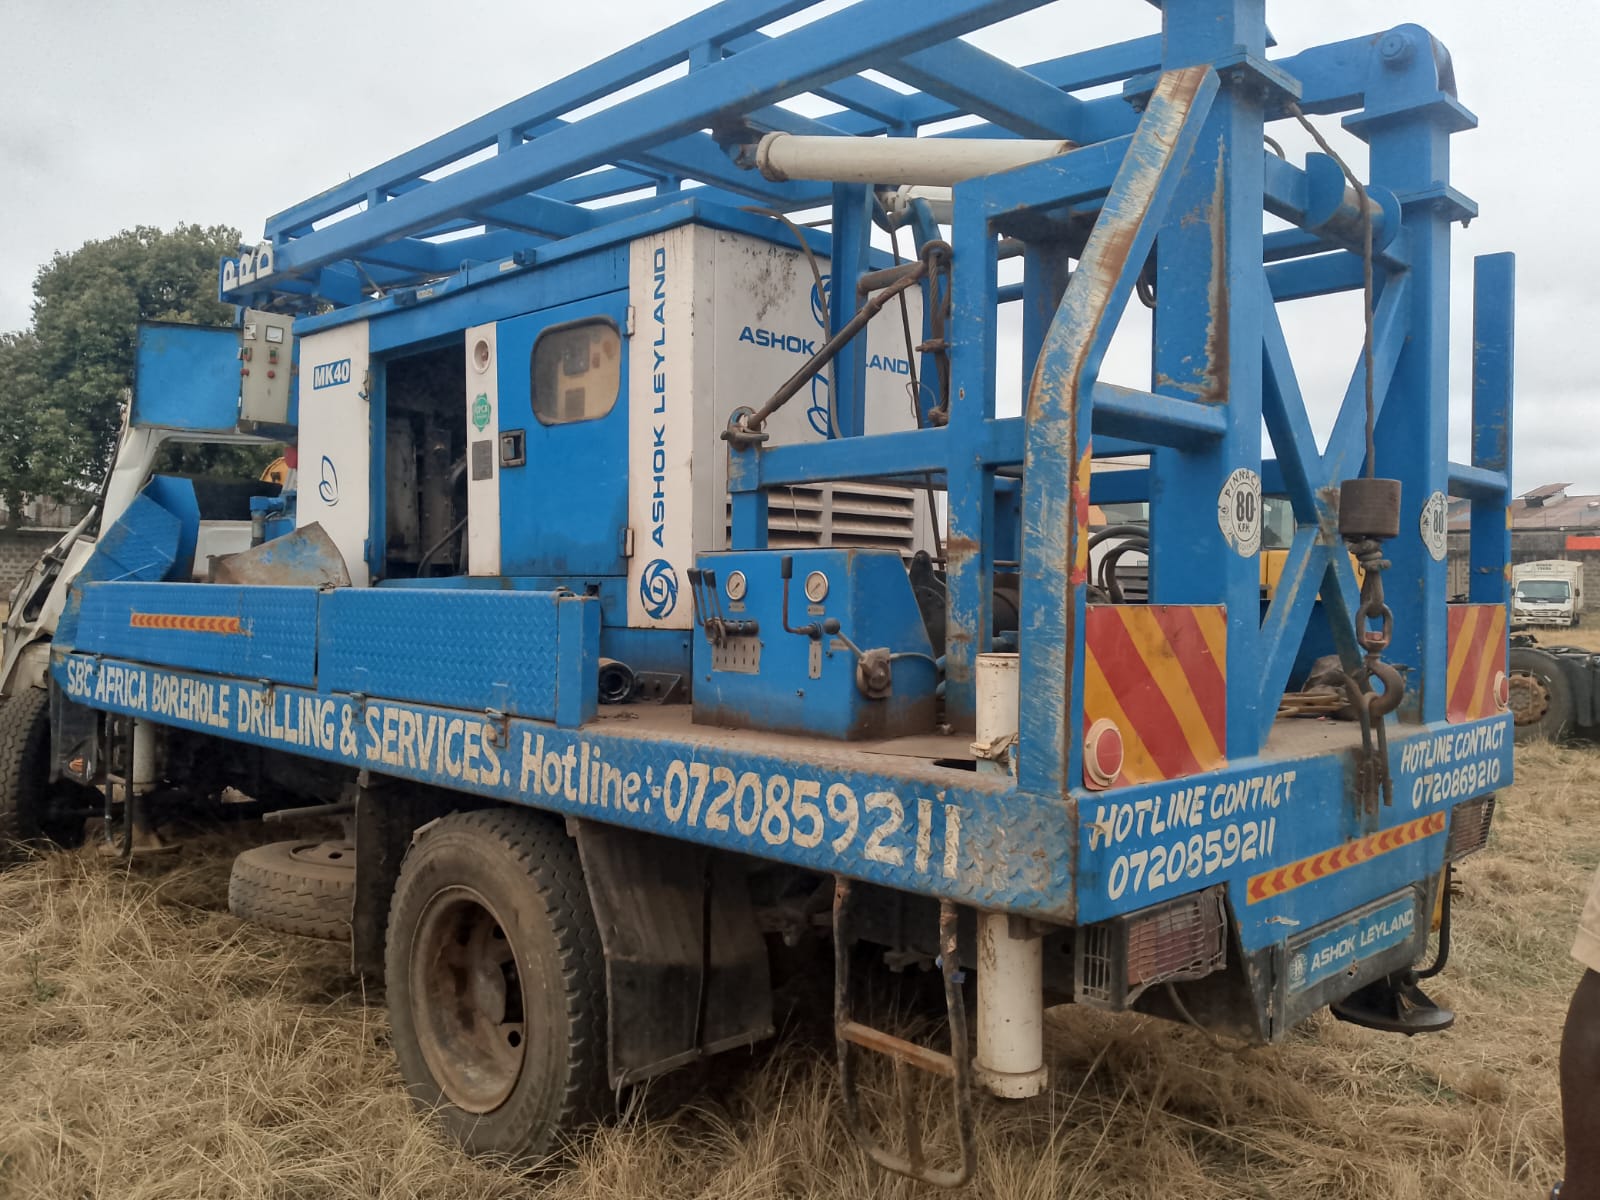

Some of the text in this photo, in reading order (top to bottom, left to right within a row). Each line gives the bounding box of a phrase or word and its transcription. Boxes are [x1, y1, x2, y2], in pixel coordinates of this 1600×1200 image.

[739, 326, 816, 356] ASHOK
[314, 360, 350, 388] MK40
[652, 247, 666, 548] ASHOK LEYLAND
[1236, 490, 1255, 523] 80
[1433, 509, 1444, 535] 80
[66, 658, 93, 698] SBC
[94, 664, 148, 712] AFRICA
[152, 672, 231, 729] BOREHOLE
[237, 687, 336, 751] DRILLING
[339, 703, 359, 760] &
[1401, 721, 1507, 775] HOTLINE CONTACT
[1088, 770, 1297, 852] HOTLINE CONTACT
[1412, 757, 1501, 811] 0720869210
[1107, 816, 1277, 901] 0720859211
[1310, 908, 1414, 973] ASHOK LEYLAND
